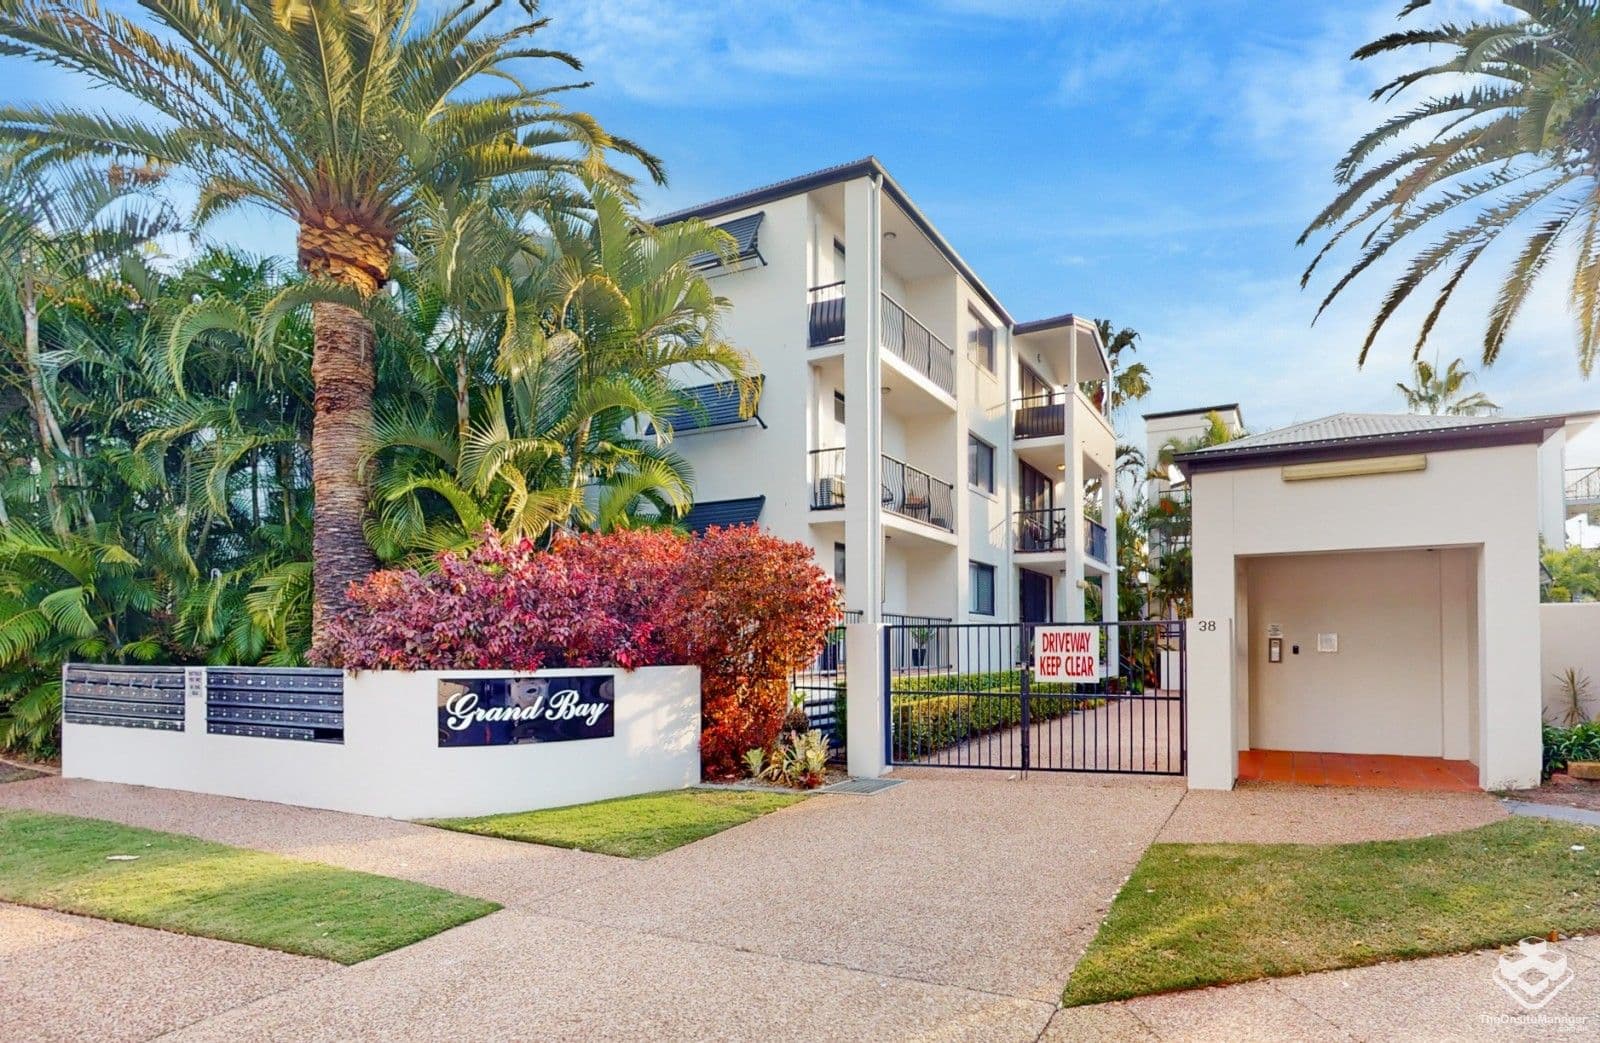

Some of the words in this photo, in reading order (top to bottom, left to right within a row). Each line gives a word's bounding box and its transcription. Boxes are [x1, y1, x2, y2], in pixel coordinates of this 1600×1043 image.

[1198, 620, 1217, 632] 38
[1042, 632, 1091, 653] DRIVEWAY
[1040, 655, 1062, 676] KEEP
[1065, 655, 1094, 676] CLEAR
[446, 692, 544, 731] Grand
[545, 689, 609, 727] Bay
